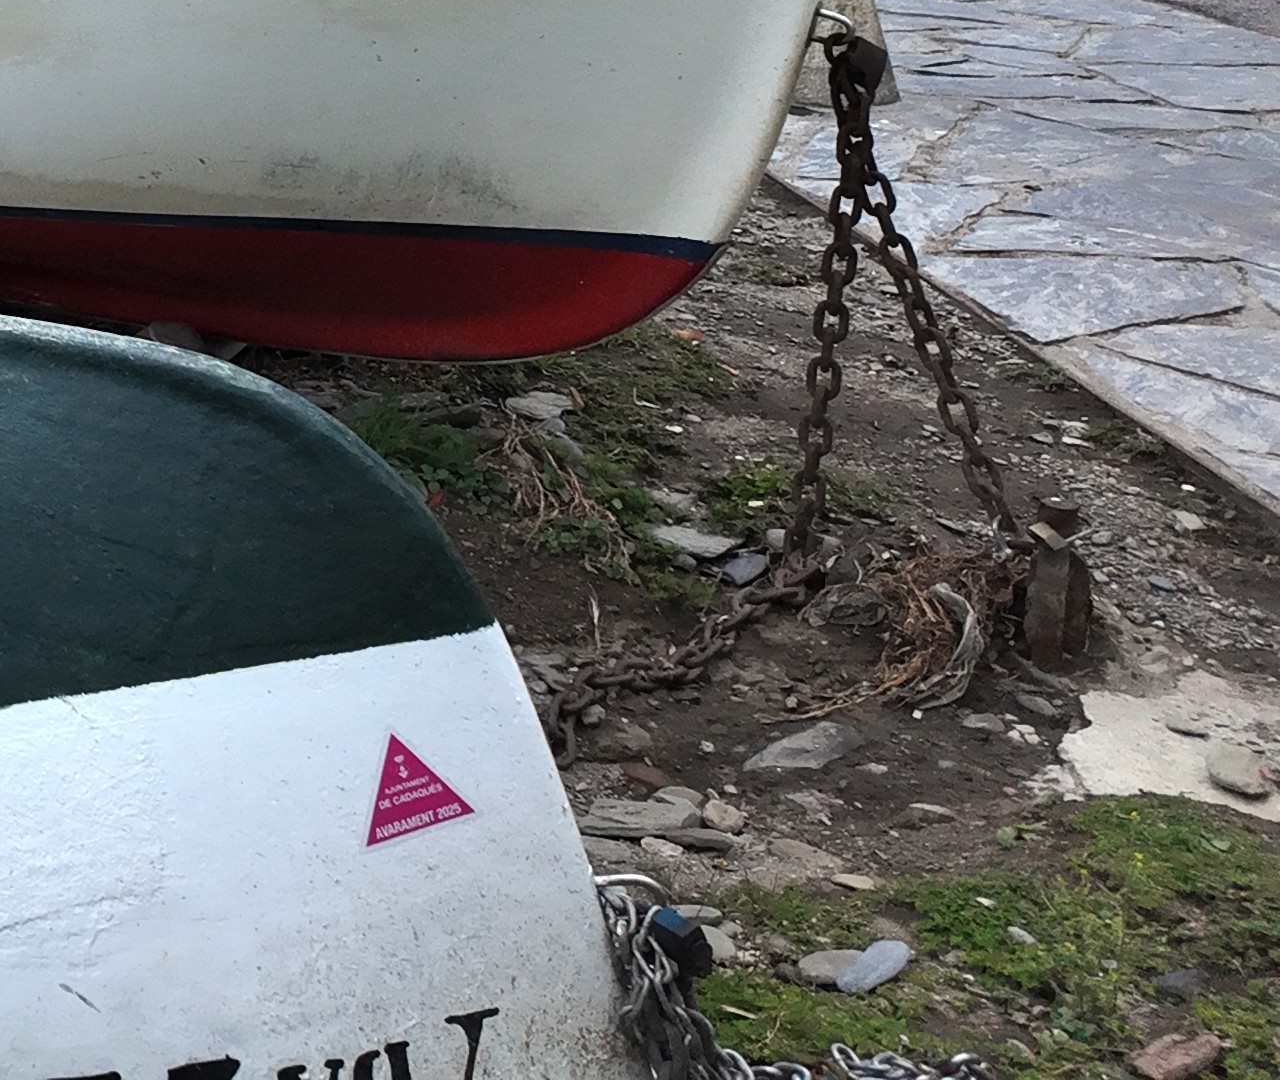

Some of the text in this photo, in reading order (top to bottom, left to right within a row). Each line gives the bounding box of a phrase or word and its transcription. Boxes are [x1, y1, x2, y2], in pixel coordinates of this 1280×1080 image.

[378, 798, 392, 810] DE
[375, 802, 462, 839] AVARAMENT 2025
